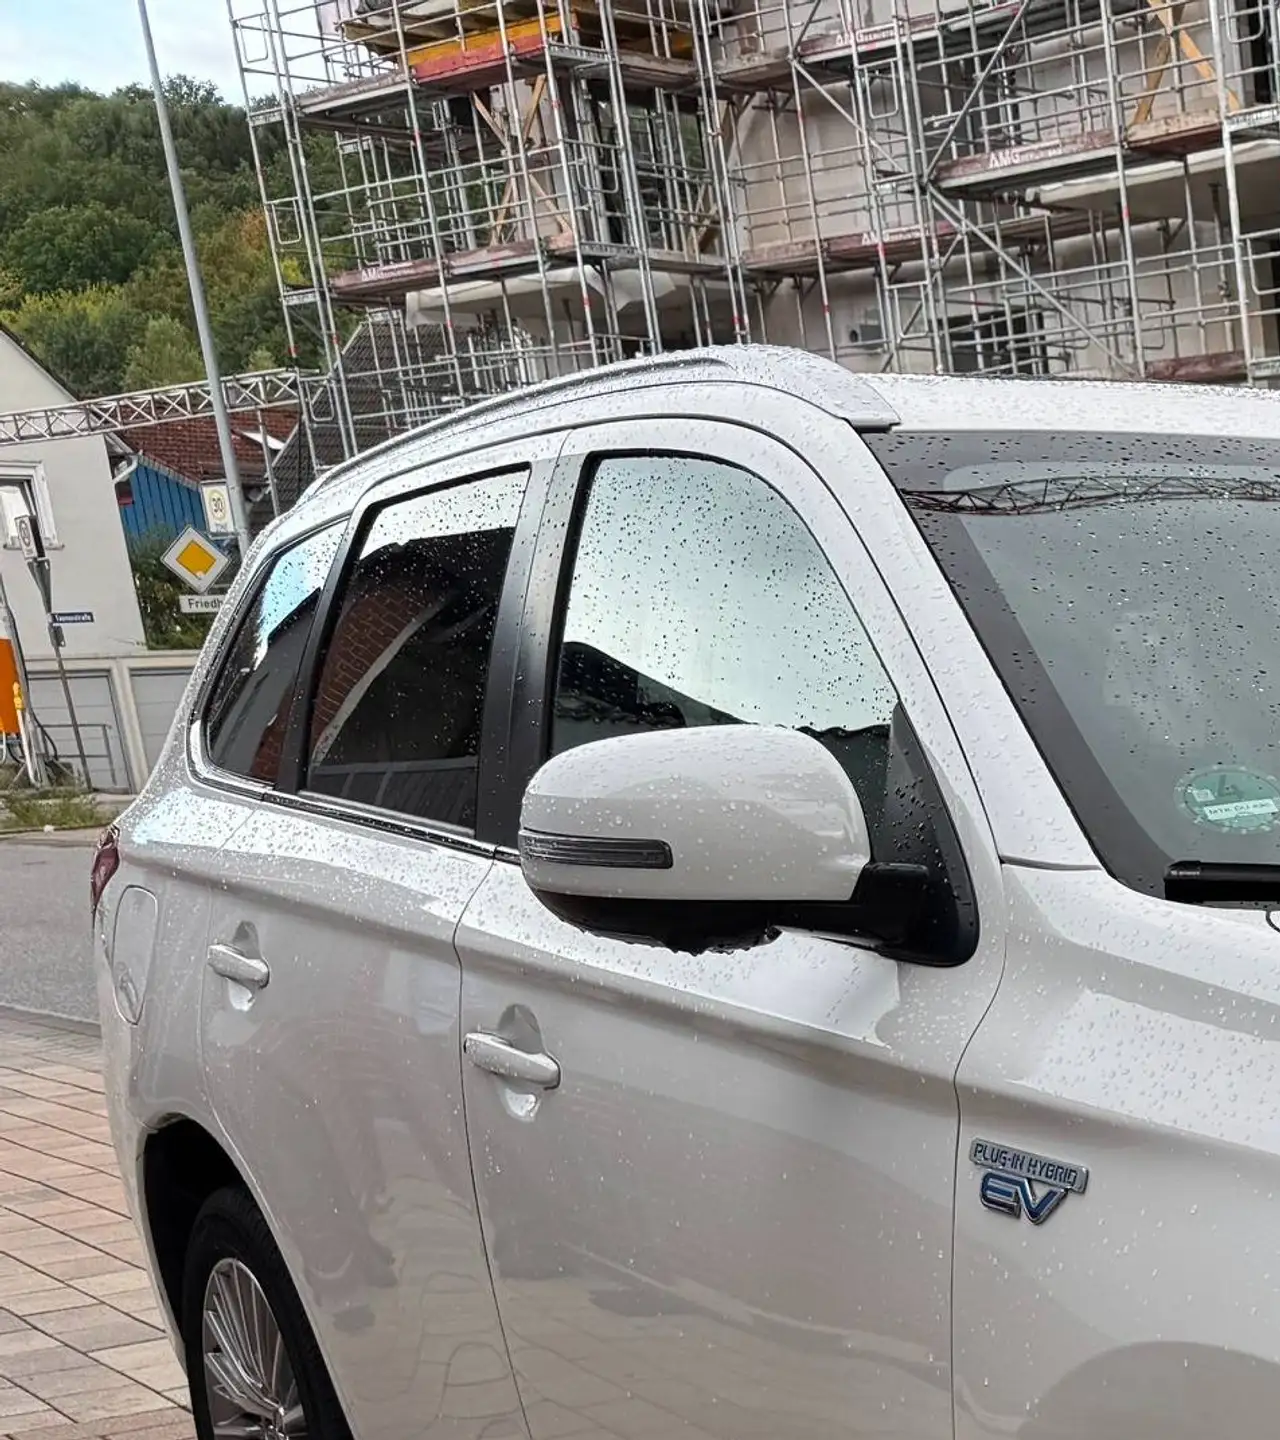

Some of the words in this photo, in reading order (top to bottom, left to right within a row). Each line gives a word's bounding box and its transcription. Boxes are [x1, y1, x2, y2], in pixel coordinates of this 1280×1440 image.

[988, 149, 1020, 168] AMG
[211, 496, 223, 514] 30
[974, 1143, 1026, 1171] PLUG-IN
[1026, 1157, 1078, 1188] HYBRID
[981, 1169, 1066, 1225] EV
